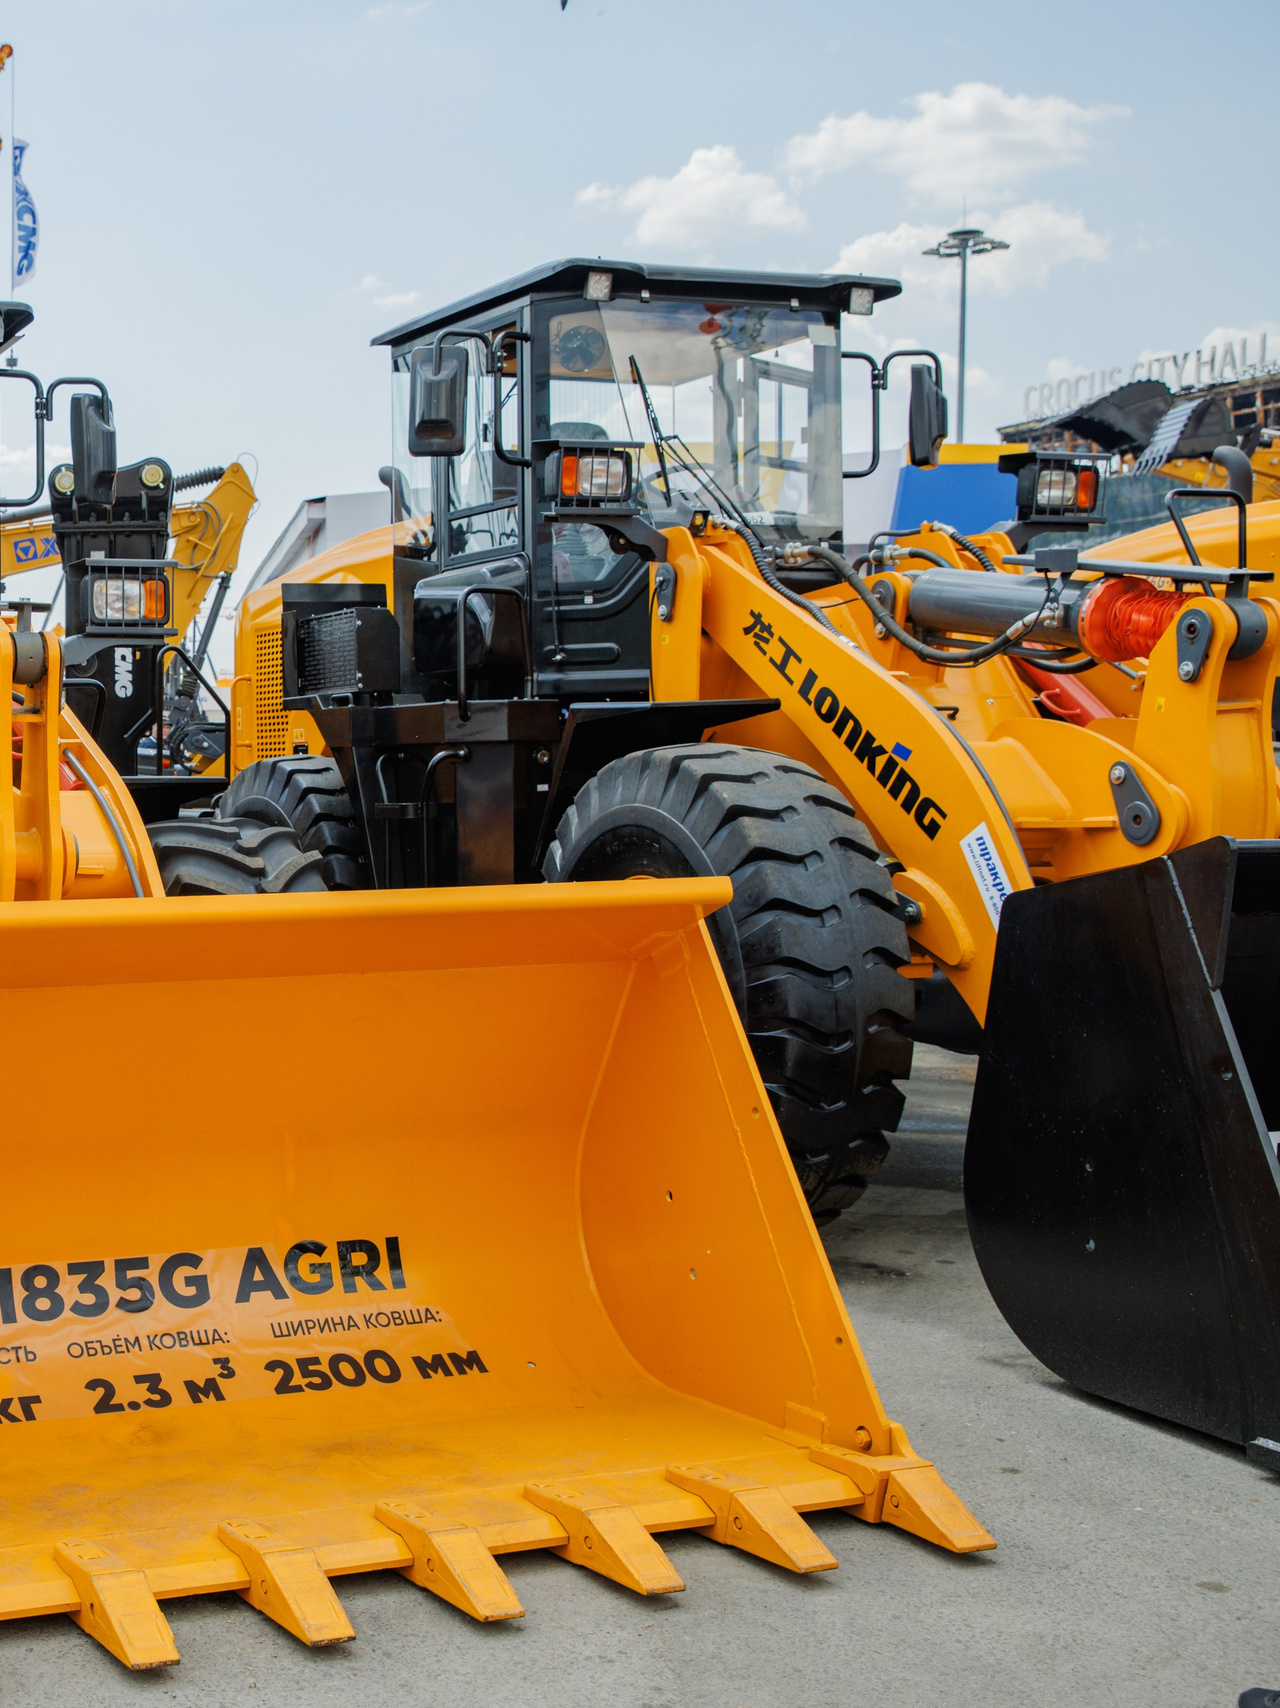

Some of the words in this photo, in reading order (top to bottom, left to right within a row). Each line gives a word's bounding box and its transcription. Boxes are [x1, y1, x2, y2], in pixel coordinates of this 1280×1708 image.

[15, 181, 37, 276] XCMG
[1023, 367, 1121, 417] CROCUS
[1129, 351, 1190, 389] CITY
[1196, 332, 1277, 383] HALL
[114, 647, 133, 698] CMG
[234, 1236, 407, 1304] AGRI
[146, 1328, 231, 1351] КОВША:
[270, 1314, 360, 1338] ШИРИНА
[363, 1307, 443, 1329] КОВША:
[84, 1373, 172, 1414] 2.3
[264, 1349, 401, 1395] 2500
